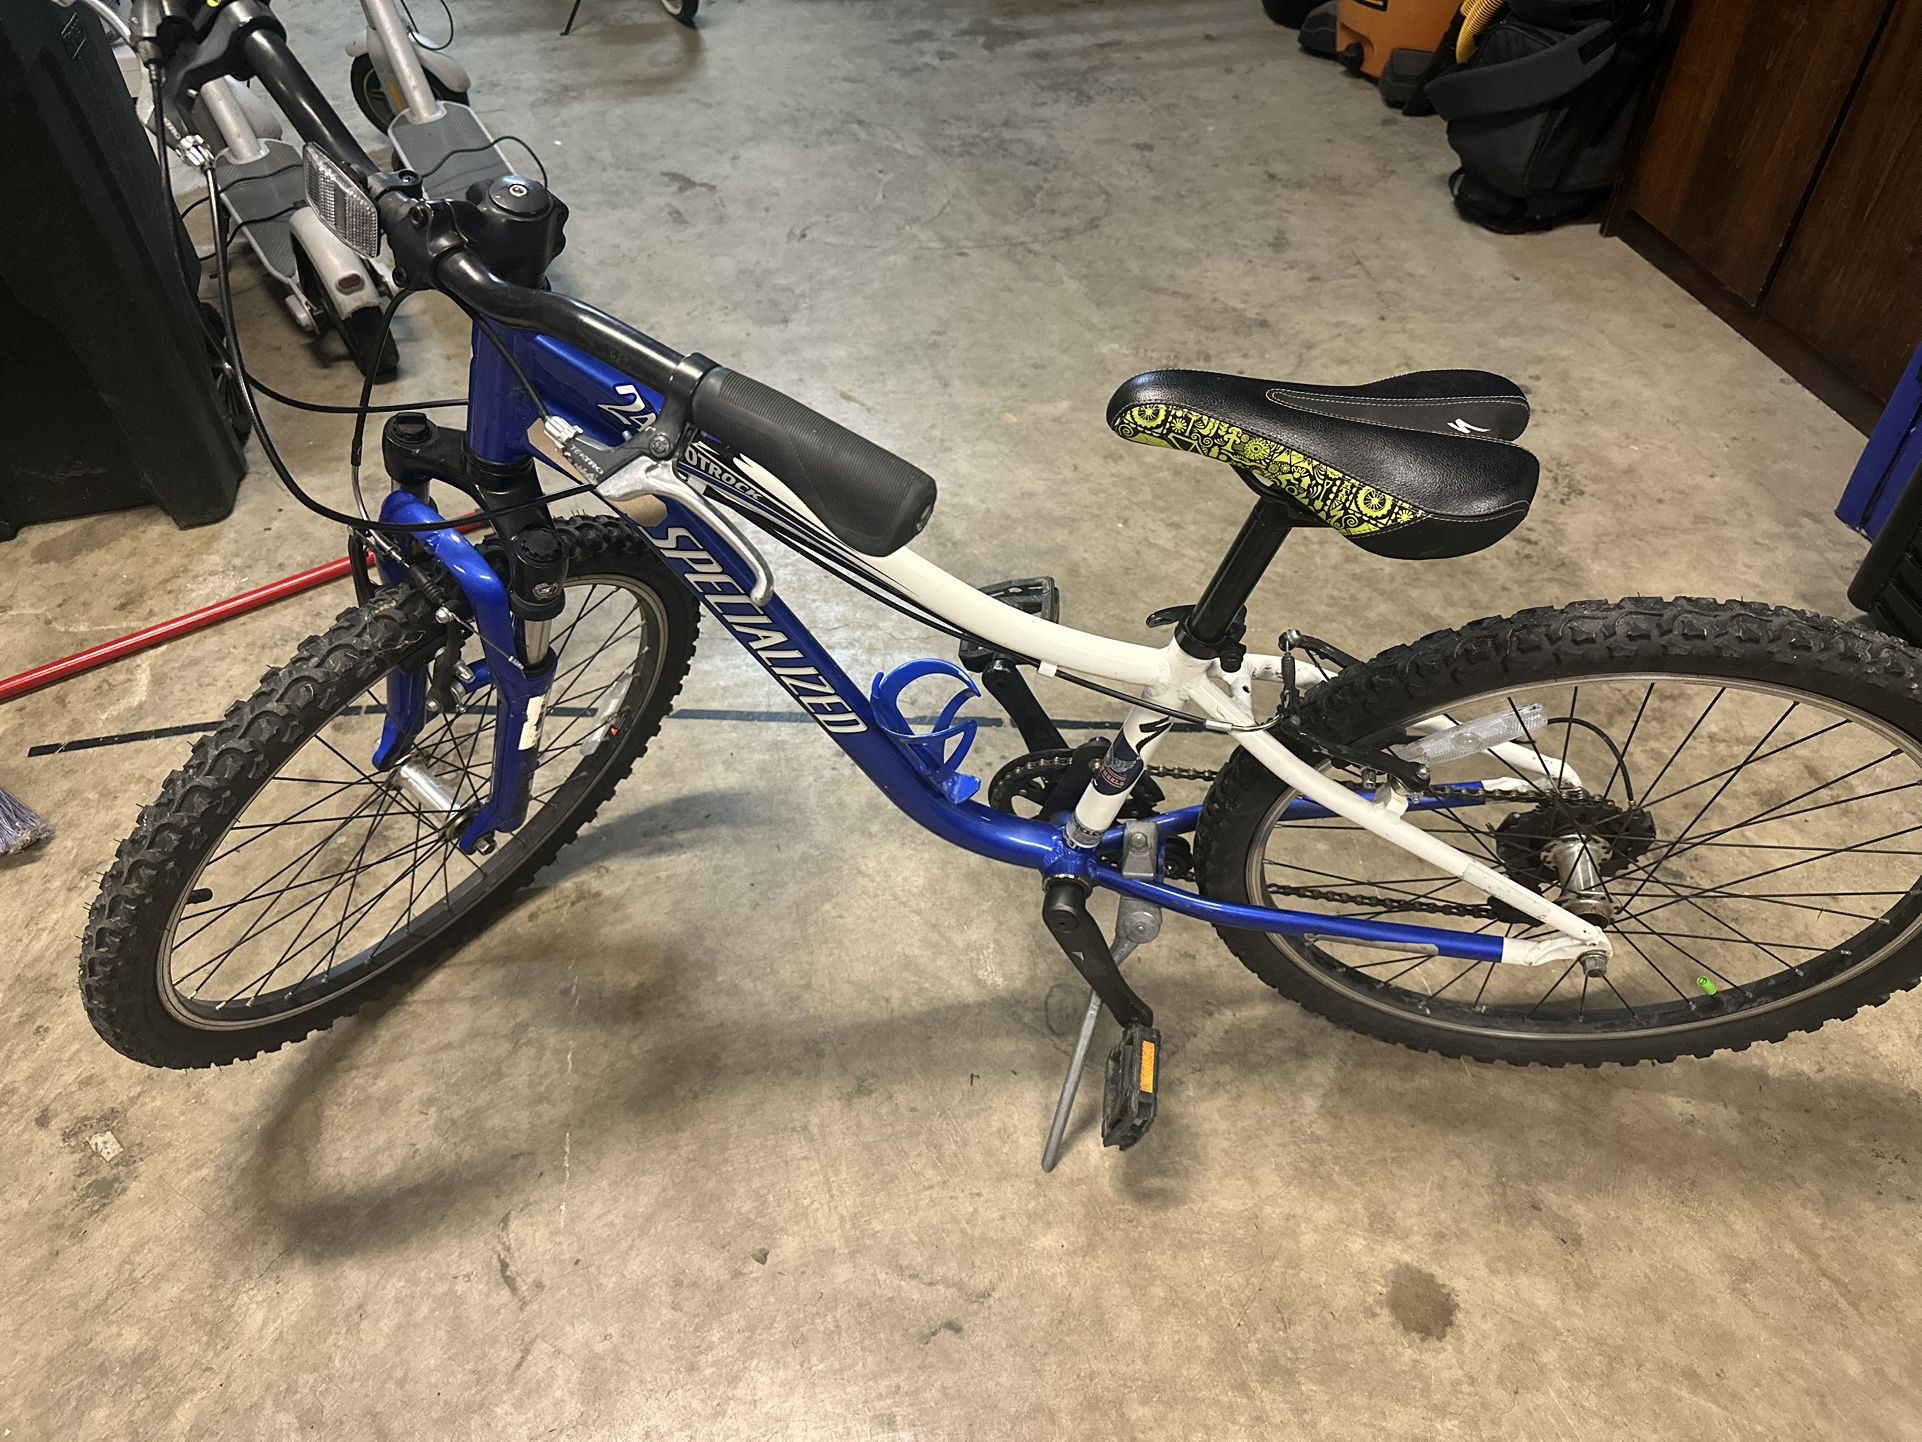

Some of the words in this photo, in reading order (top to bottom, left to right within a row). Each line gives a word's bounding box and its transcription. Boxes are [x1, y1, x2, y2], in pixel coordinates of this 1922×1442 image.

[597, 384, 657, 432] 24
[570, 444, 604, 475] TEKTRO
[684, 445, 763, 500] OTROCK
[636, 525, 868, 734] SPECIALIZED
